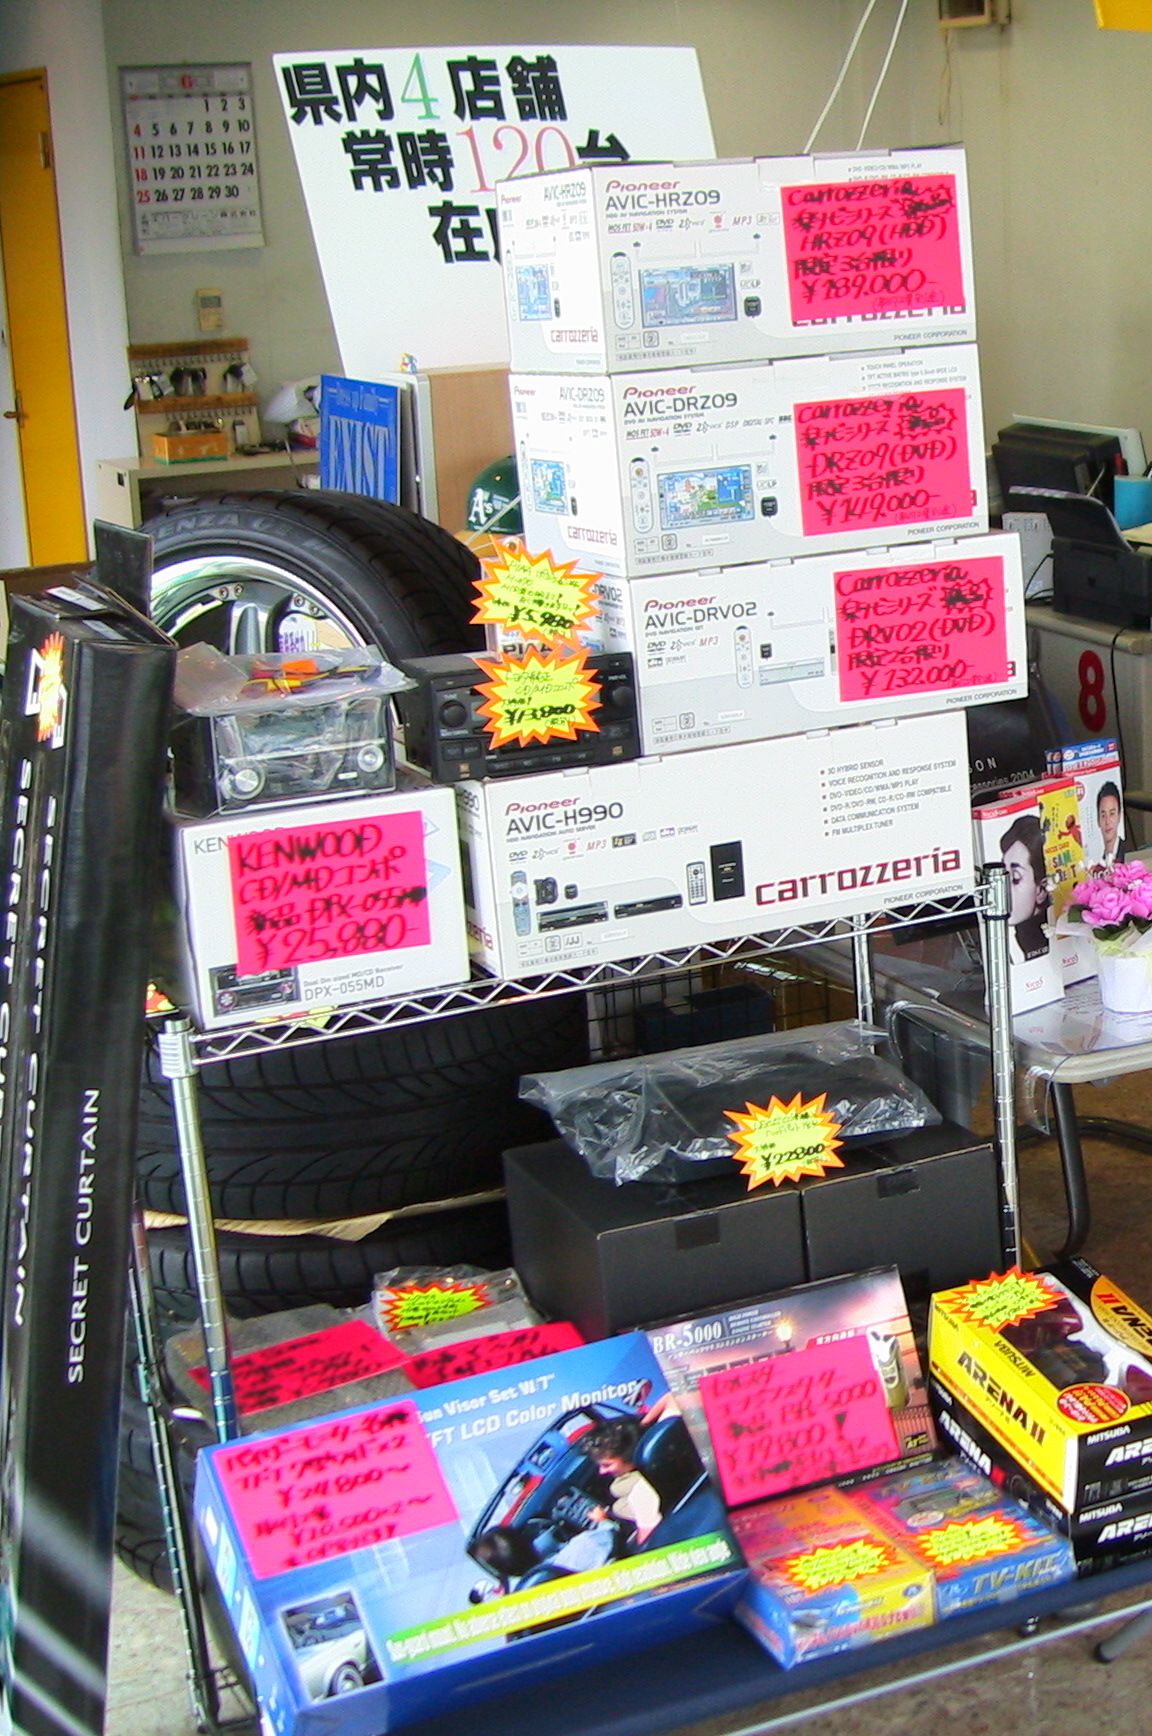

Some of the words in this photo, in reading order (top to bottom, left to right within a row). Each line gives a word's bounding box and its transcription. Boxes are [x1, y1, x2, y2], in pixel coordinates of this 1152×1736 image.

[281, 52, 569, 126] 県内4店舗
[204, 99, 210, 112] 1
[221, 98, 228, 111] 2
[238, 98, 246, 110] 3
[133, 123, 141, 137] 4
[152, 123, 160, 136] 5
[170, 122, 177, 136] 6
[187, 121, 194, 135] 7
[205, 120, 213, 133] 8
[222, 120, 230, 133] 9
[237, 119, 250, 132] 10
[134, 146, 145, 160] 11
[151, 145, 164, 159] 12
[169, 144, 181, 158] 13
[187, 143, 200, 157] 14
[205, 142, 217, 156] 15
[222, 142, 234, 155] 16
[239, 141, 251, 154] 17
[135, 168, 148, 182] 18
[153, 167, 165, 180] 19
[170, 167, 184, 180] 20
[189, 166, 201, 179] 21
[206, 165, 219, 178] 22
[223, 164, 237, 177] 23
[241, 163, 254, 176] 24
[137, 190, 150, 203] 25
[154, 189, 168, 202] 26
[172, 188, 185, 201] 27
[190, 187, 204, 200] 28
[208, 186, 221, 199] 29
[225, 185, 239, 198] 30
[605, 179, 680, 193] Pioneer
[605, 189, 721, 211] AVIC-HRZ09
[427, 200, 502, 264] 在
[623, 385, 696, 400] Pioneer
[624, 392, 738, 417] AVIC-DRZ09
[936, 521, 980, 533] CORPORATION
[644, 595, 717, 613] Pioneer
[645, 601, 758, 630] AVIC-DRV02
[699, 635, 719, 647] MP3
[946, 694, 973, 704] PIONEER
[974, 688, 1017, 701] CORPORATION
[1078, 650, 1107, 732] 8
[828, 778, 846, 787] VOICE
[847, 771, 887, 784] RECOGNITION
[902, 764, 932, 775] RESPONSE
[933, 759, 957, 770] SYSTEM
[836, 763, 859, 774] HYBRID
[860, 759, 884, 769] SENSOR
[1010, 768, 1036, 783] 2004
[505, 797, 581, 816] Pioneer
[831, 815, 846, 824] DATA
[847, 807, 895, 822] COMMUNICATION
[896, 802, 920, 813] SYSTEM
[506, 801, 624, 835] AVIC-H990
[842, 822, 873, 835] MULTIPLEX
[874, 819, 894, 829] TUNER
[233, 824, 383, 879] KENWOOD
[586, 839, 607, 851] MP3
[884, 892, 914, 904] PIONEER
[915, 884, 964, 899] CORPORATION
[304, 976, 385, 1001] DPX-055MD
[76, 1088, 101, 1247] CURTAIN
[68, 1257, 91, 1384] SECRET
[653, 1320, 722, 1355] BR-5000
[443, 1394, 486, 1416] Visor
[488, 1385, 518, 1404] Set
[957, 1350, 1028, 1433] ARENA
[427, 1426, 458, 1449] FT
[461, 1414, 501, 1440] LCD
[504, 1402, 557, 1428] Color
[560, 1380, 640, 1412] Monitor
[938, 1410, 993, 1477] ARENA
[1086, 1424, 1131, 1446] MITSUBA
[1079, 1502, 1123, 1524] MITSUBA
